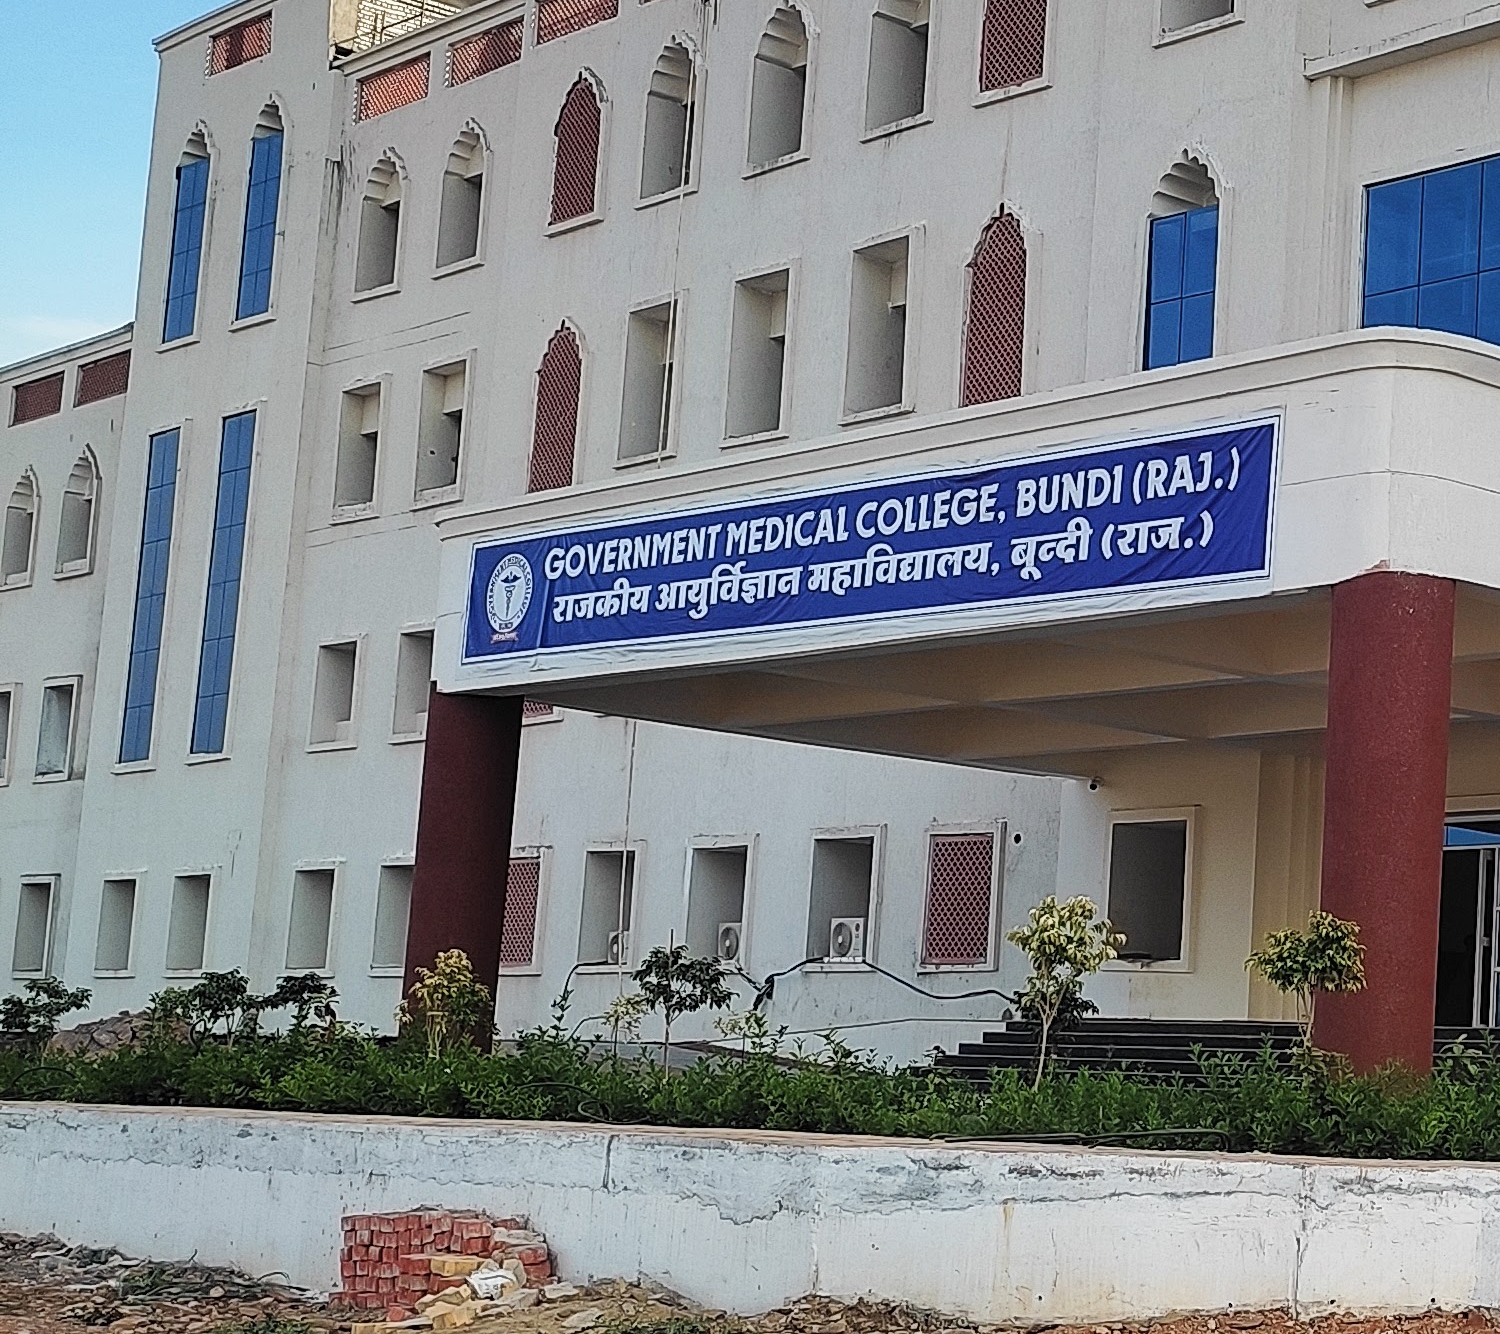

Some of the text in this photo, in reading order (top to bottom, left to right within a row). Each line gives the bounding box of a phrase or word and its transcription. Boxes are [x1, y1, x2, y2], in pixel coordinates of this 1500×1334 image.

[544, 447, 1240, 580] GOVERNMENT MEDICAL COLLEGE, BUNDI (RAJ.)
[553, 510, 1214, 623] राजकीय आयुर्विज्ञान महाविद्यालय, बून्दी (राज.)
